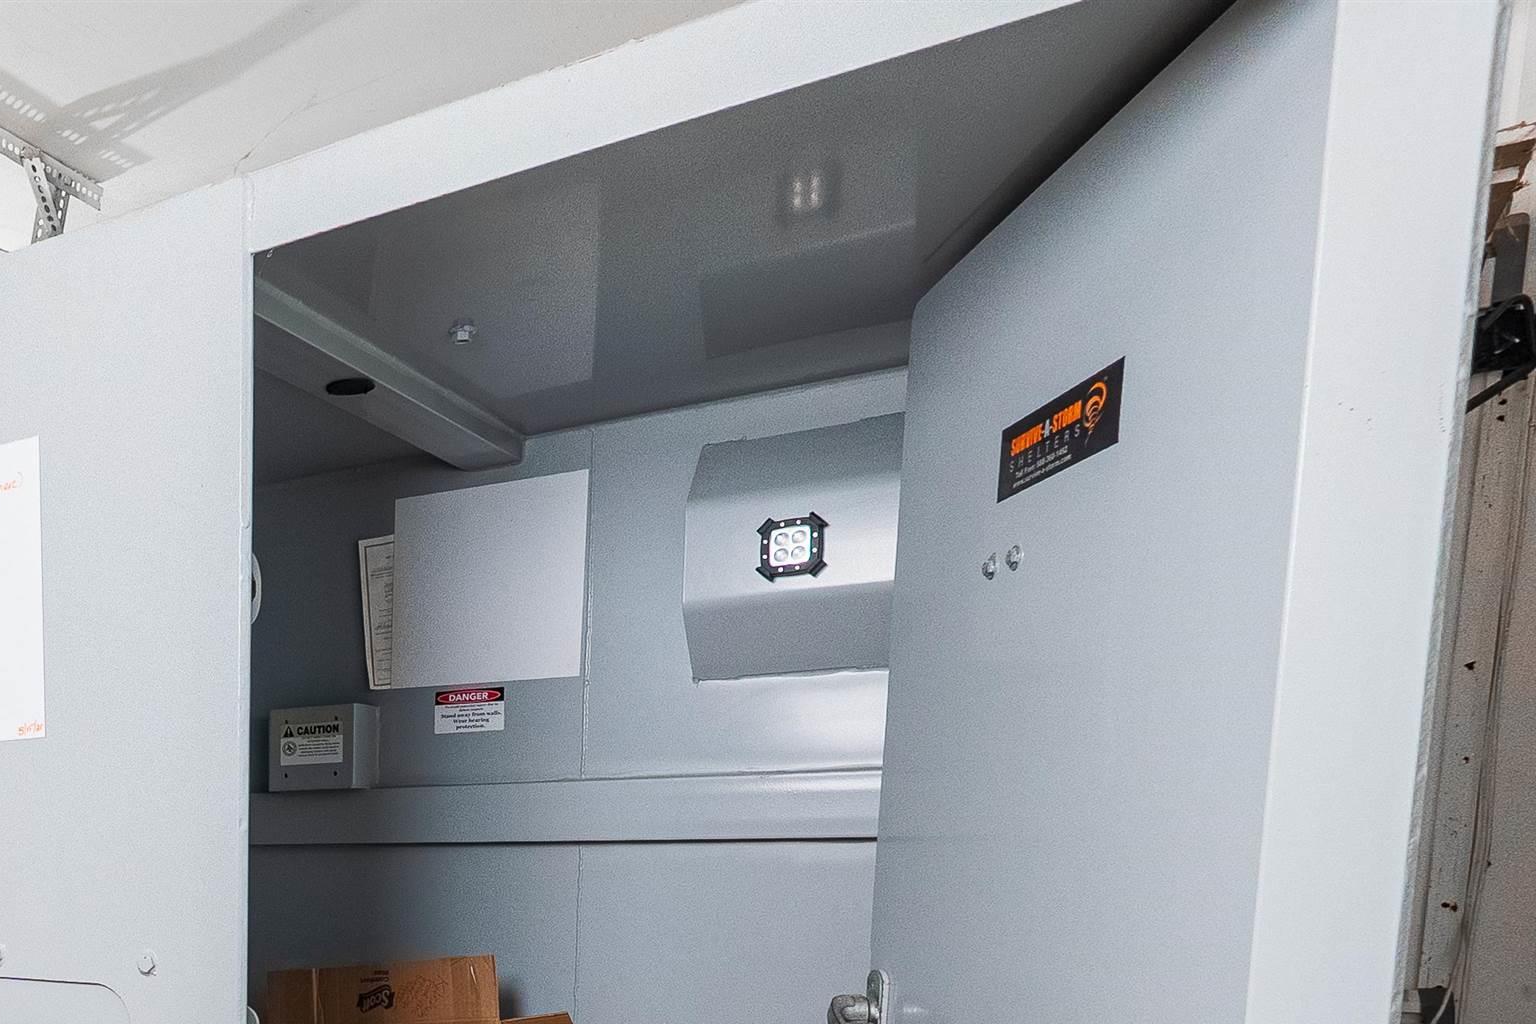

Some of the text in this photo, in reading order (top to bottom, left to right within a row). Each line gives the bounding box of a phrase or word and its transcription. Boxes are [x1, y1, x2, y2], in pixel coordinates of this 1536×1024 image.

[1009, 423, 1081, 473] SHELTERS
[448, 692, 489, 702] DANGER
[296, 723, 340, 736] CAUTION
